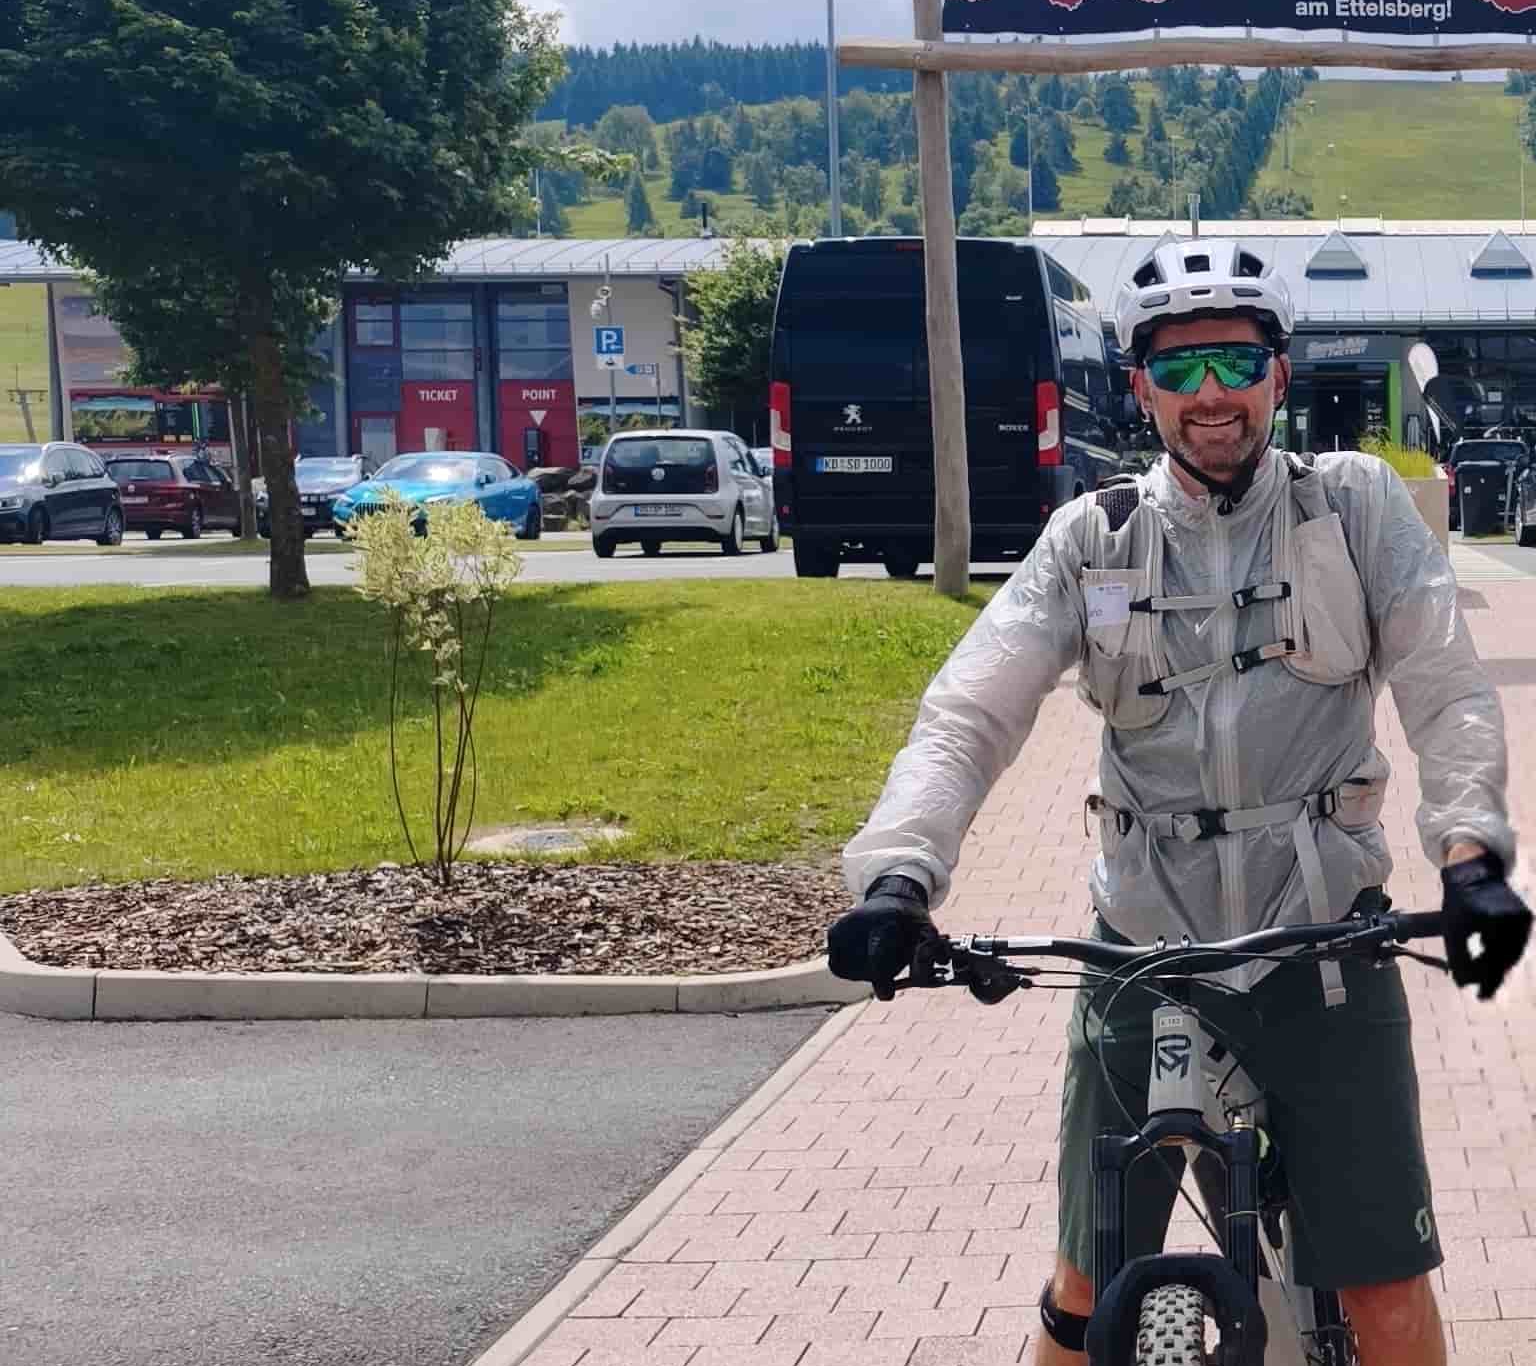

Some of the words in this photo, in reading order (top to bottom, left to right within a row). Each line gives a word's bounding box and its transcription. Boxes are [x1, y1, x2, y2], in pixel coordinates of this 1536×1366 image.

[1295, 1, 1328, 16] am
[601, 330, 617, 352] P
[418, 389, 458, 402] TICKET
[521, 389, 557, 401] POINT
[863, 458, 891, 469] 1000
